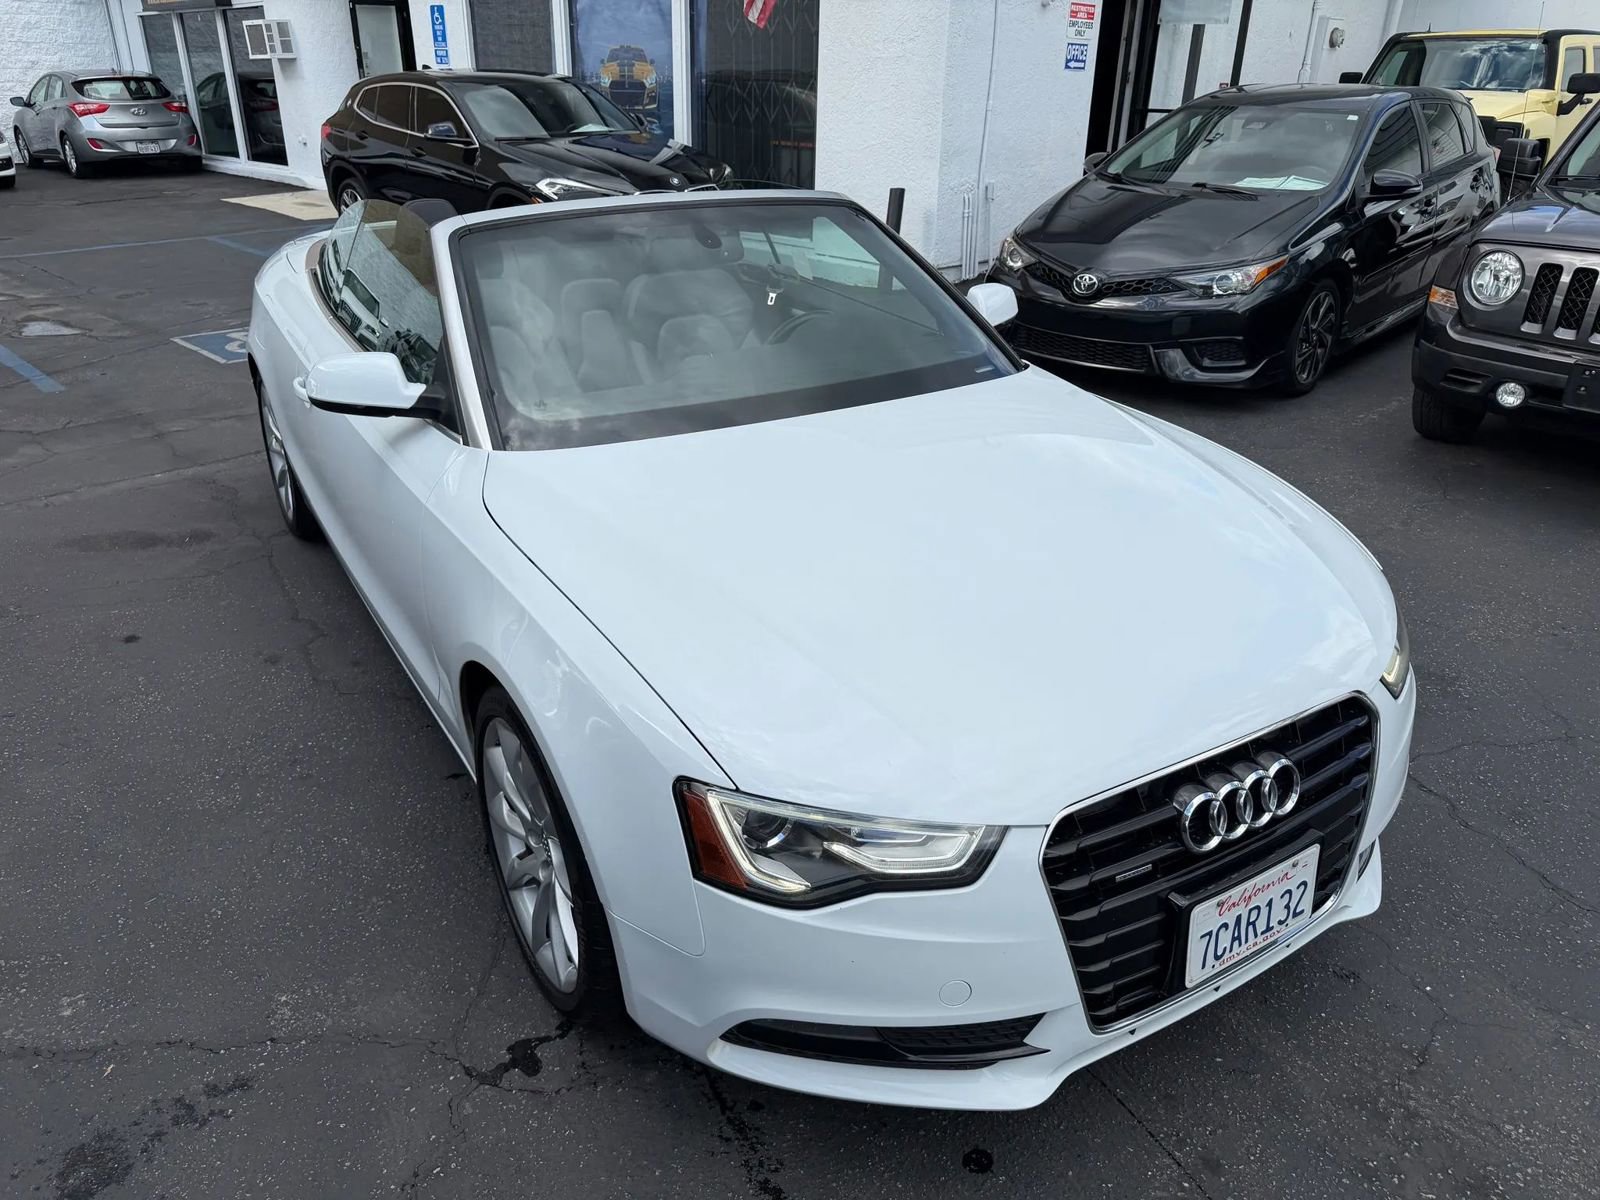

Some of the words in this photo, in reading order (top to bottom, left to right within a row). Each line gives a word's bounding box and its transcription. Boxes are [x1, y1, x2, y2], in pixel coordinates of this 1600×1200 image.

[1069, 20, 1093, 29] EMPLOYEES
[1067, 44, 1087, 60] OFFICE
[1217, 870, 1297, 917] California
[1200, 880, 1309, 970] 7CAR132
